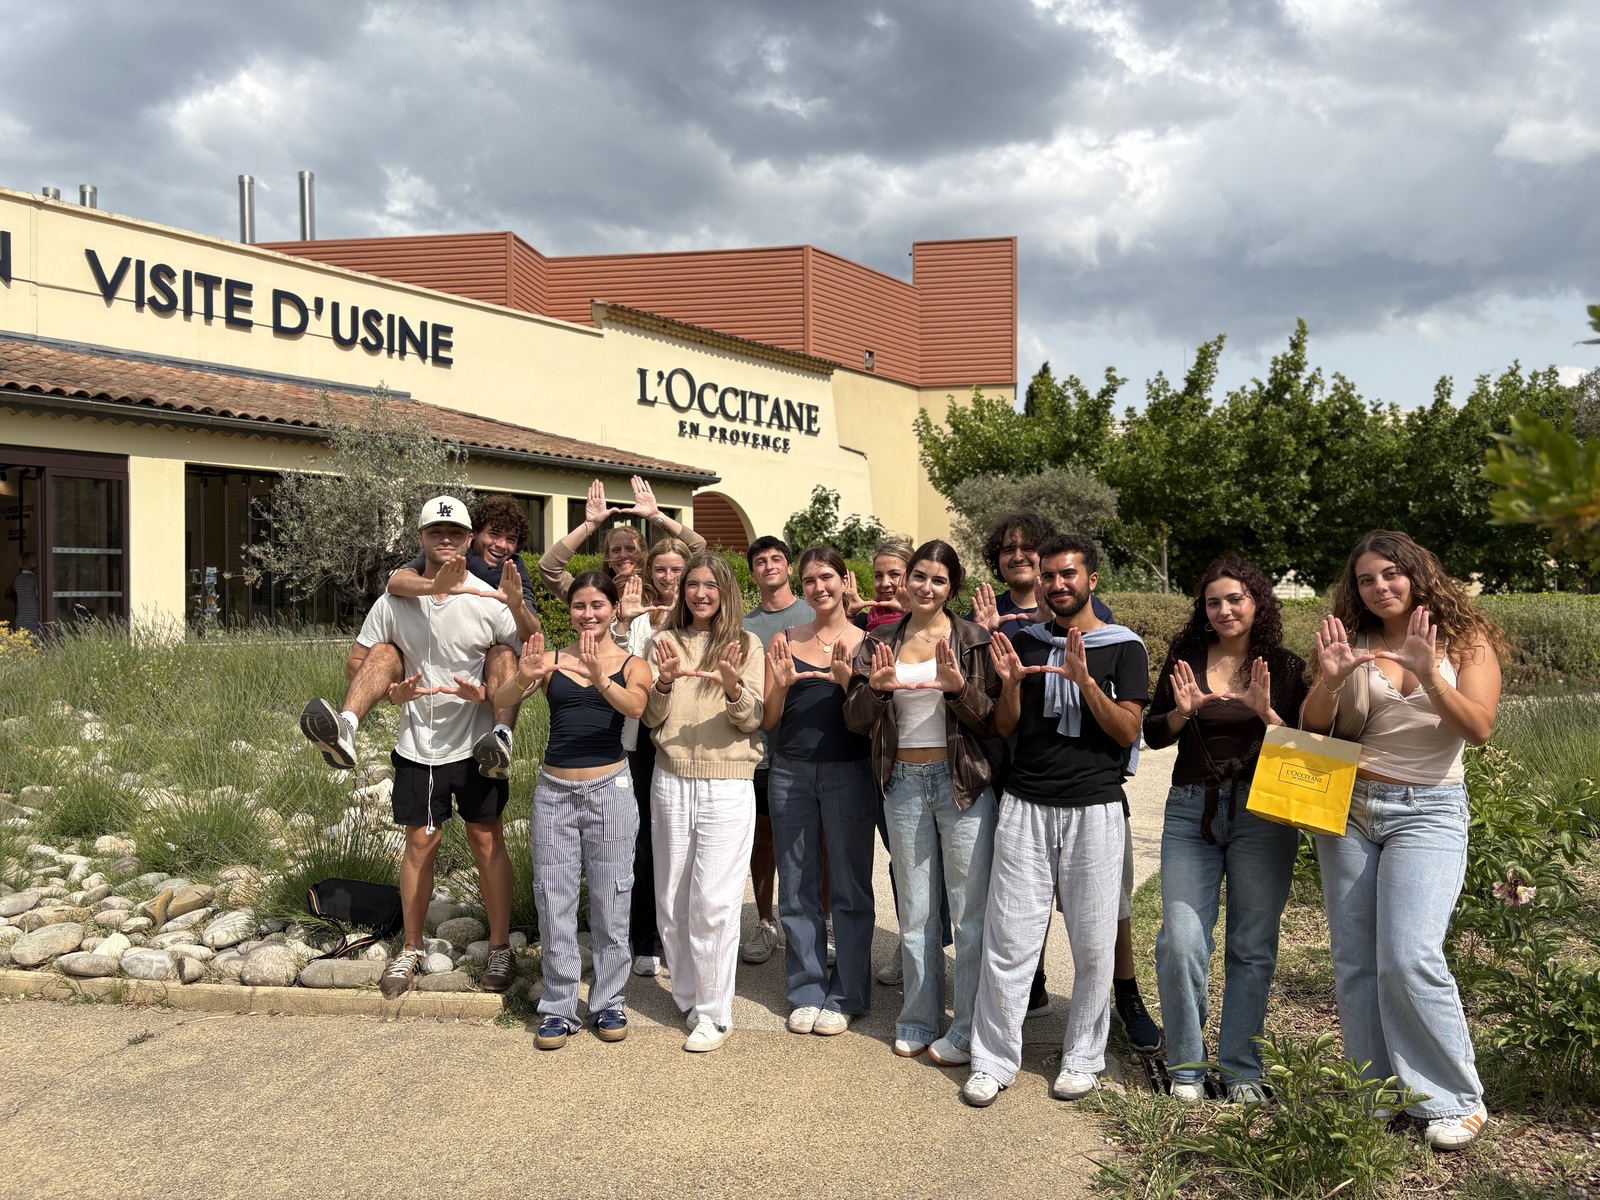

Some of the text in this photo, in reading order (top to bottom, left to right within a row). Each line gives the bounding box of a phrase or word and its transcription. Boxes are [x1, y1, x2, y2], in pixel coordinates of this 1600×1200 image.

[84, 248, 254, 327] VISITE
[272, 287, 454, 365] D'USINE
[636, 367, 821, 434] L'OCCITANE
[678, 420, 791, 452] EN PROVENCE
[437, 502, 453, 517] LA
